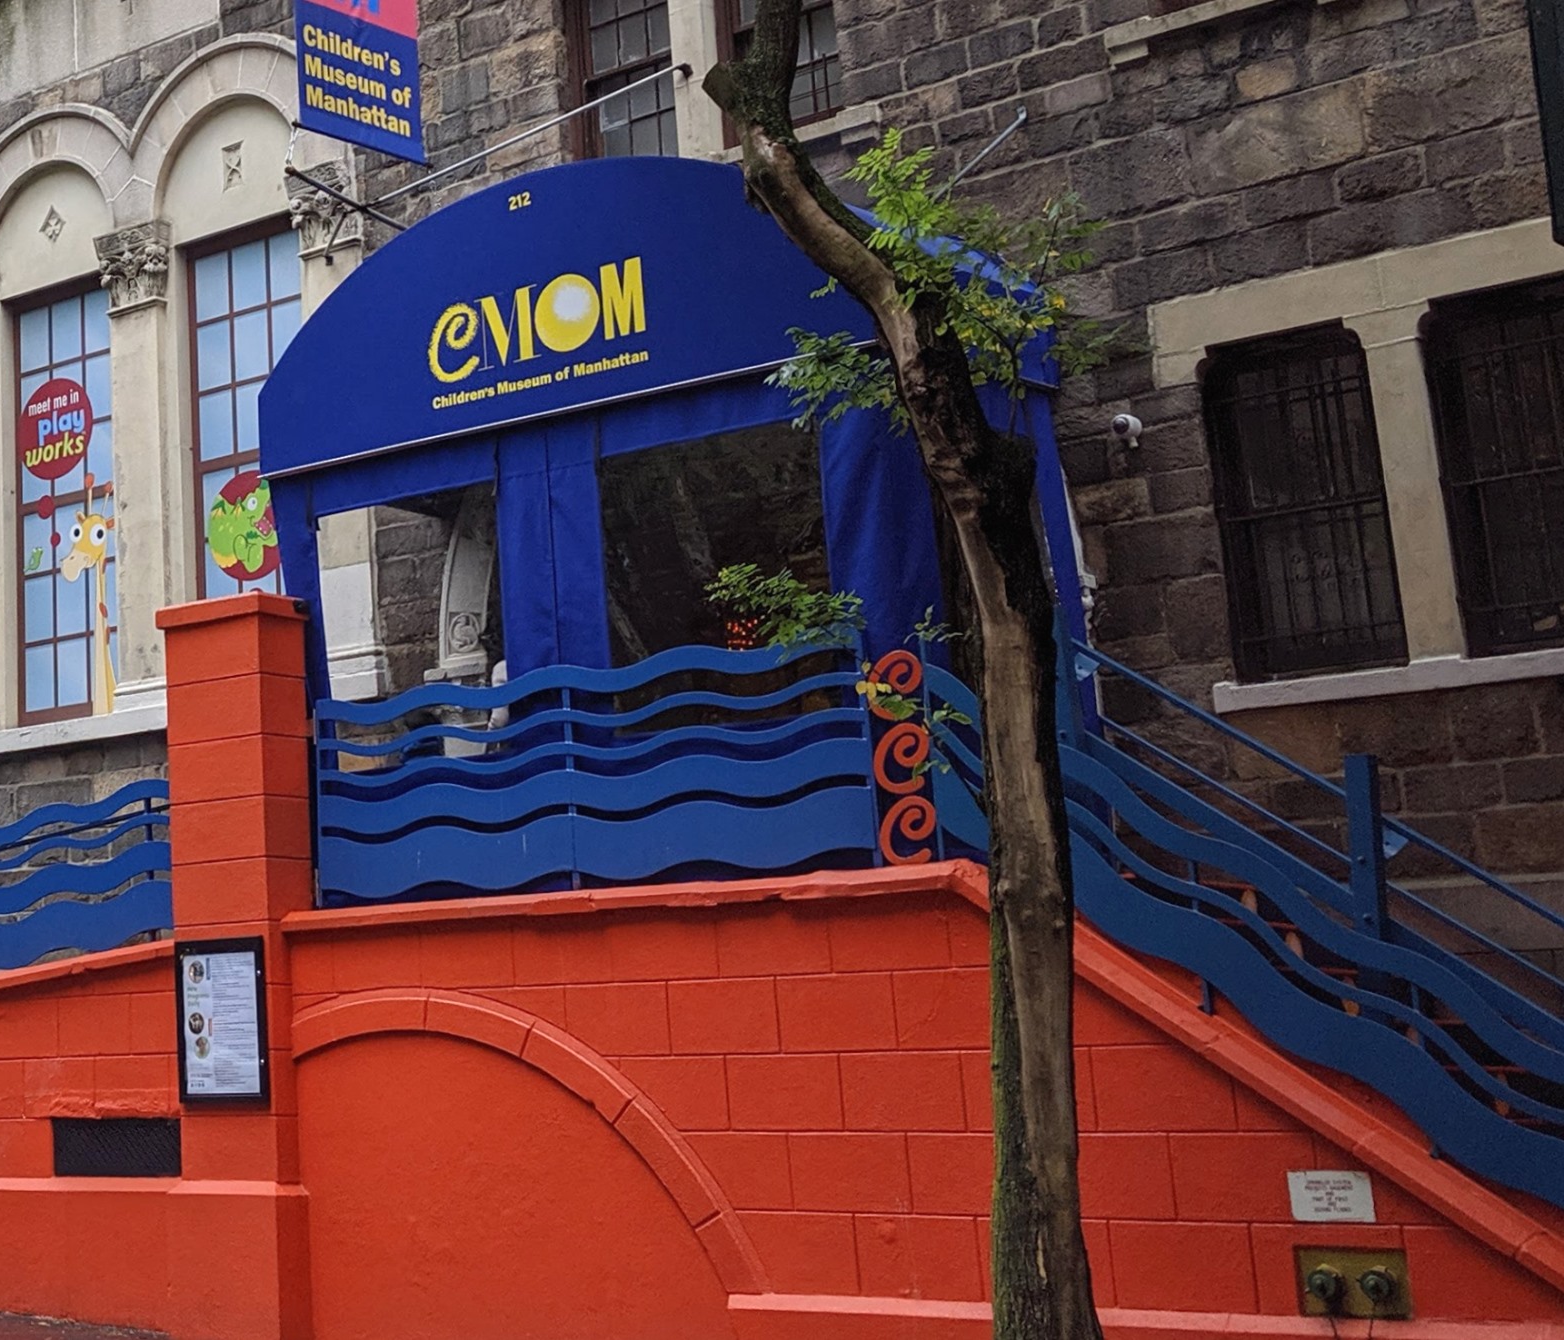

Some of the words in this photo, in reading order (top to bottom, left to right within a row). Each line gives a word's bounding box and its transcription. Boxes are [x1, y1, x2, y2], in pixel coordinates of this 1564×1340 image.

[303, 24, 402, 77] Children's
[304, 53, 387, 101] Museum
[391, 86, 412, 108] of
[305, 83, 411, 138] Manhattan
[508, 191, 532, 211] 212
[427, 256, 646, 383] CMOM
[28, 397, 51, 417] meet
[53, 394, 68, 409] me
[70, 388, 80, 405] in
[432, 386, 495, 410] Children's
[496, 373, 552, 395] Museum
[555, 366, 570, 382] of
[573, 351, 649, 377] Manhattan
[25, 431, 85, 468] works
[38, 409, 85, 447] play
